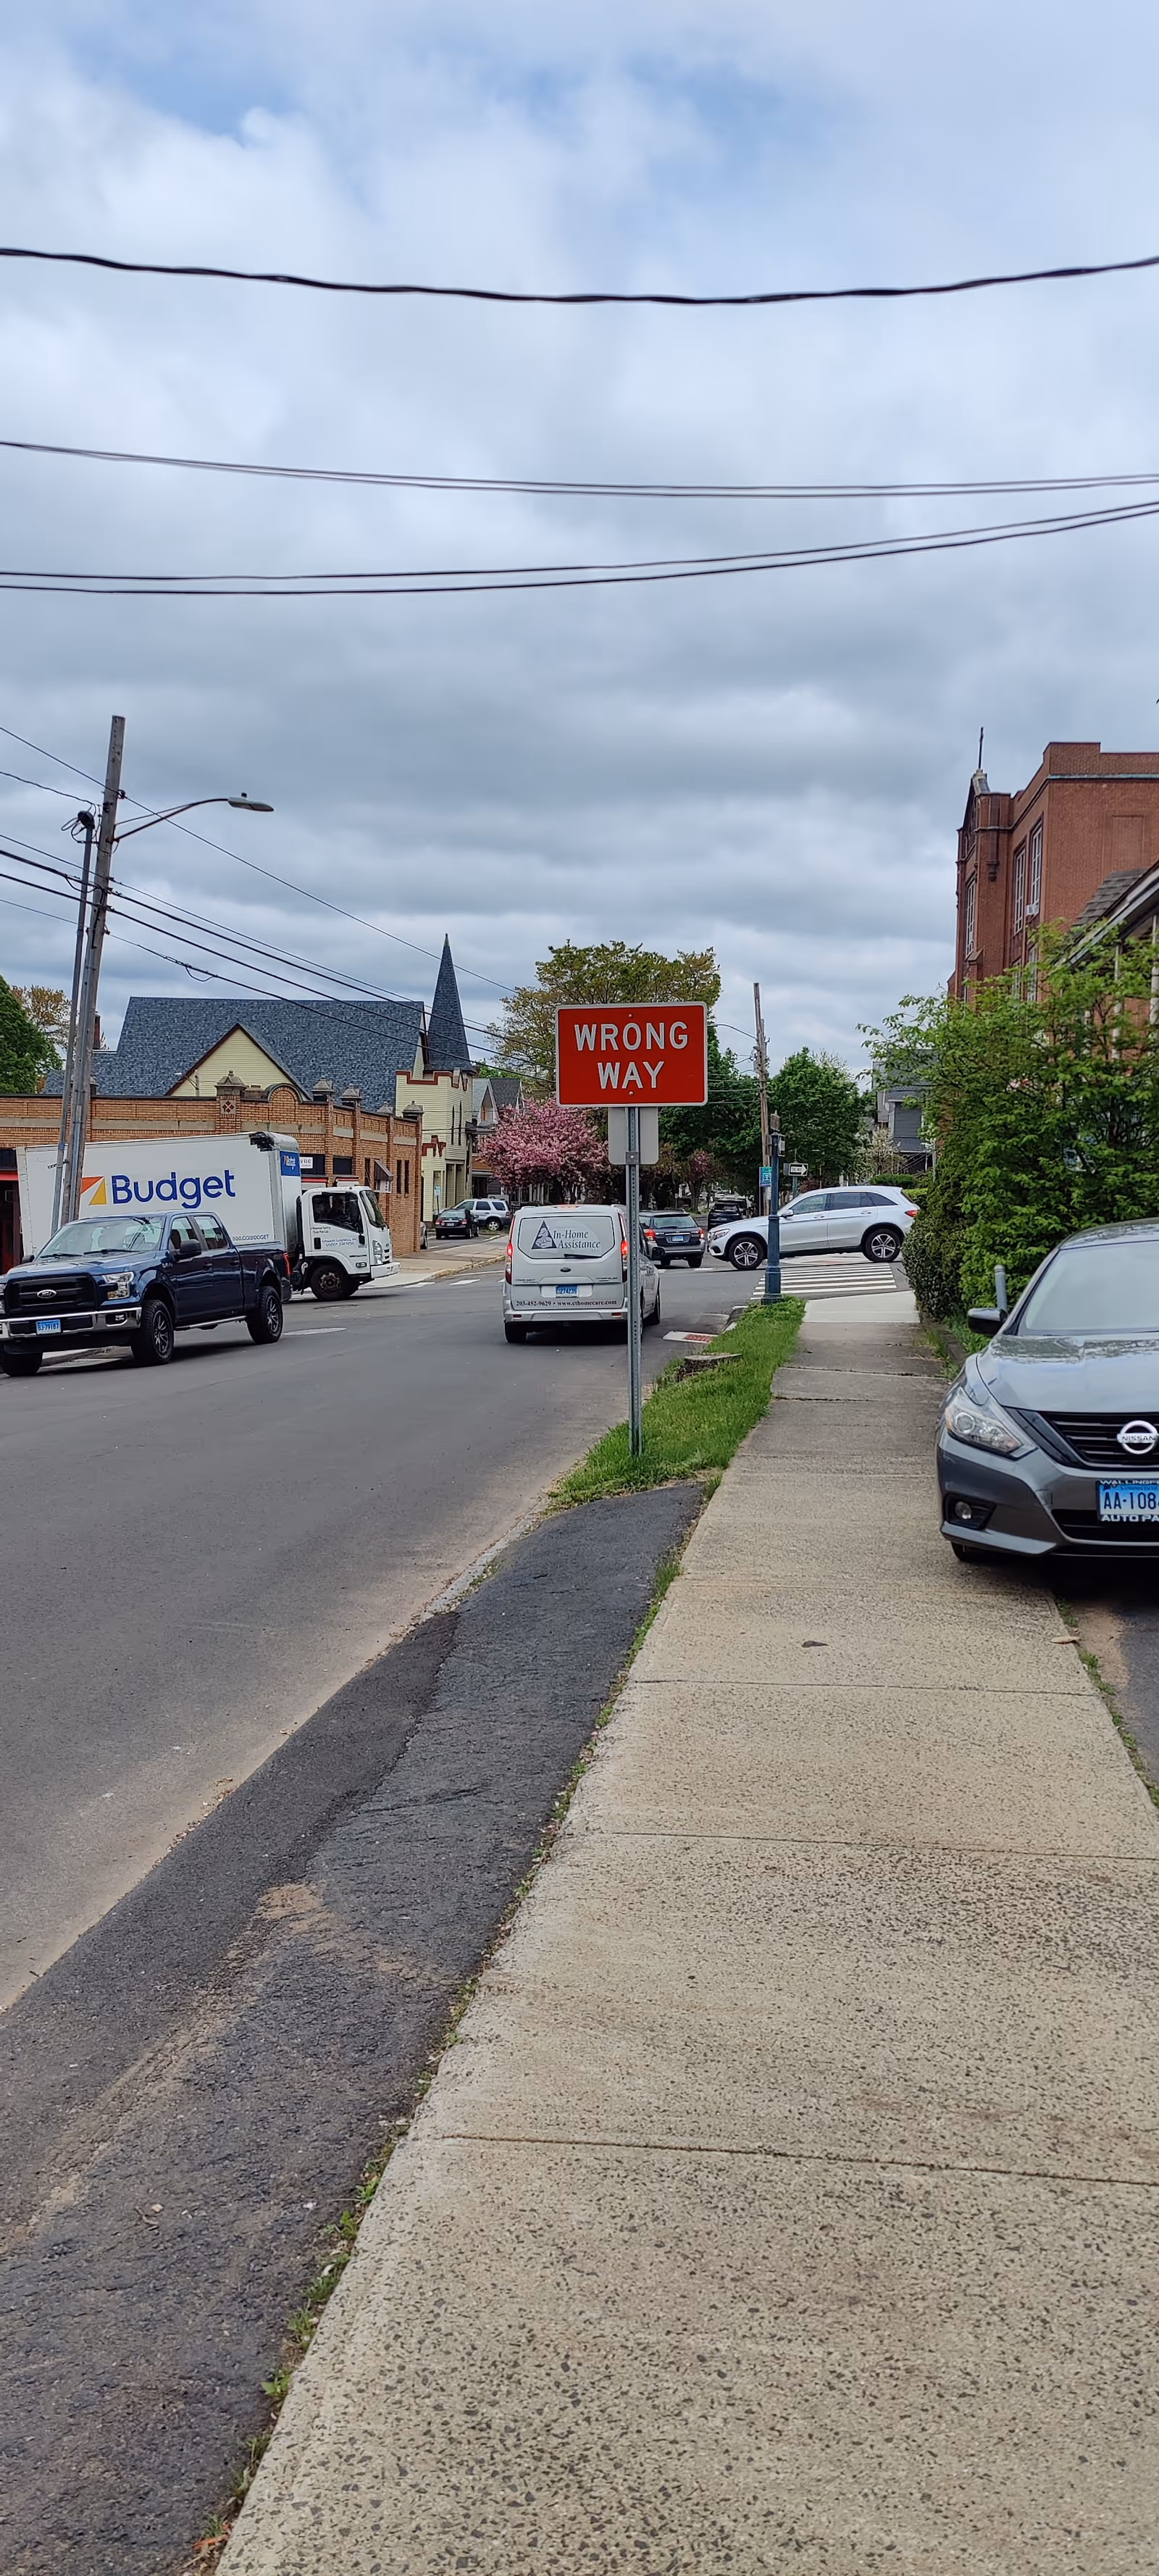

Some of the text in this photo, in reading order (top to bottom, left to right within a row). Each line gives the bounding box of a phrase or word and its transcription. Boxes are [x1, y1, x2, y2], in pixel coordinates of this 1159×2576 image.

[574, 1021, 687, 1051] WRONG
[597, 1061, 664, 1090] WAY
[111, 1169, 236, 1209] Budget
[553, 1229, 588, 1239] In-Home
[557, 1239, 601, 1249] Assistance
